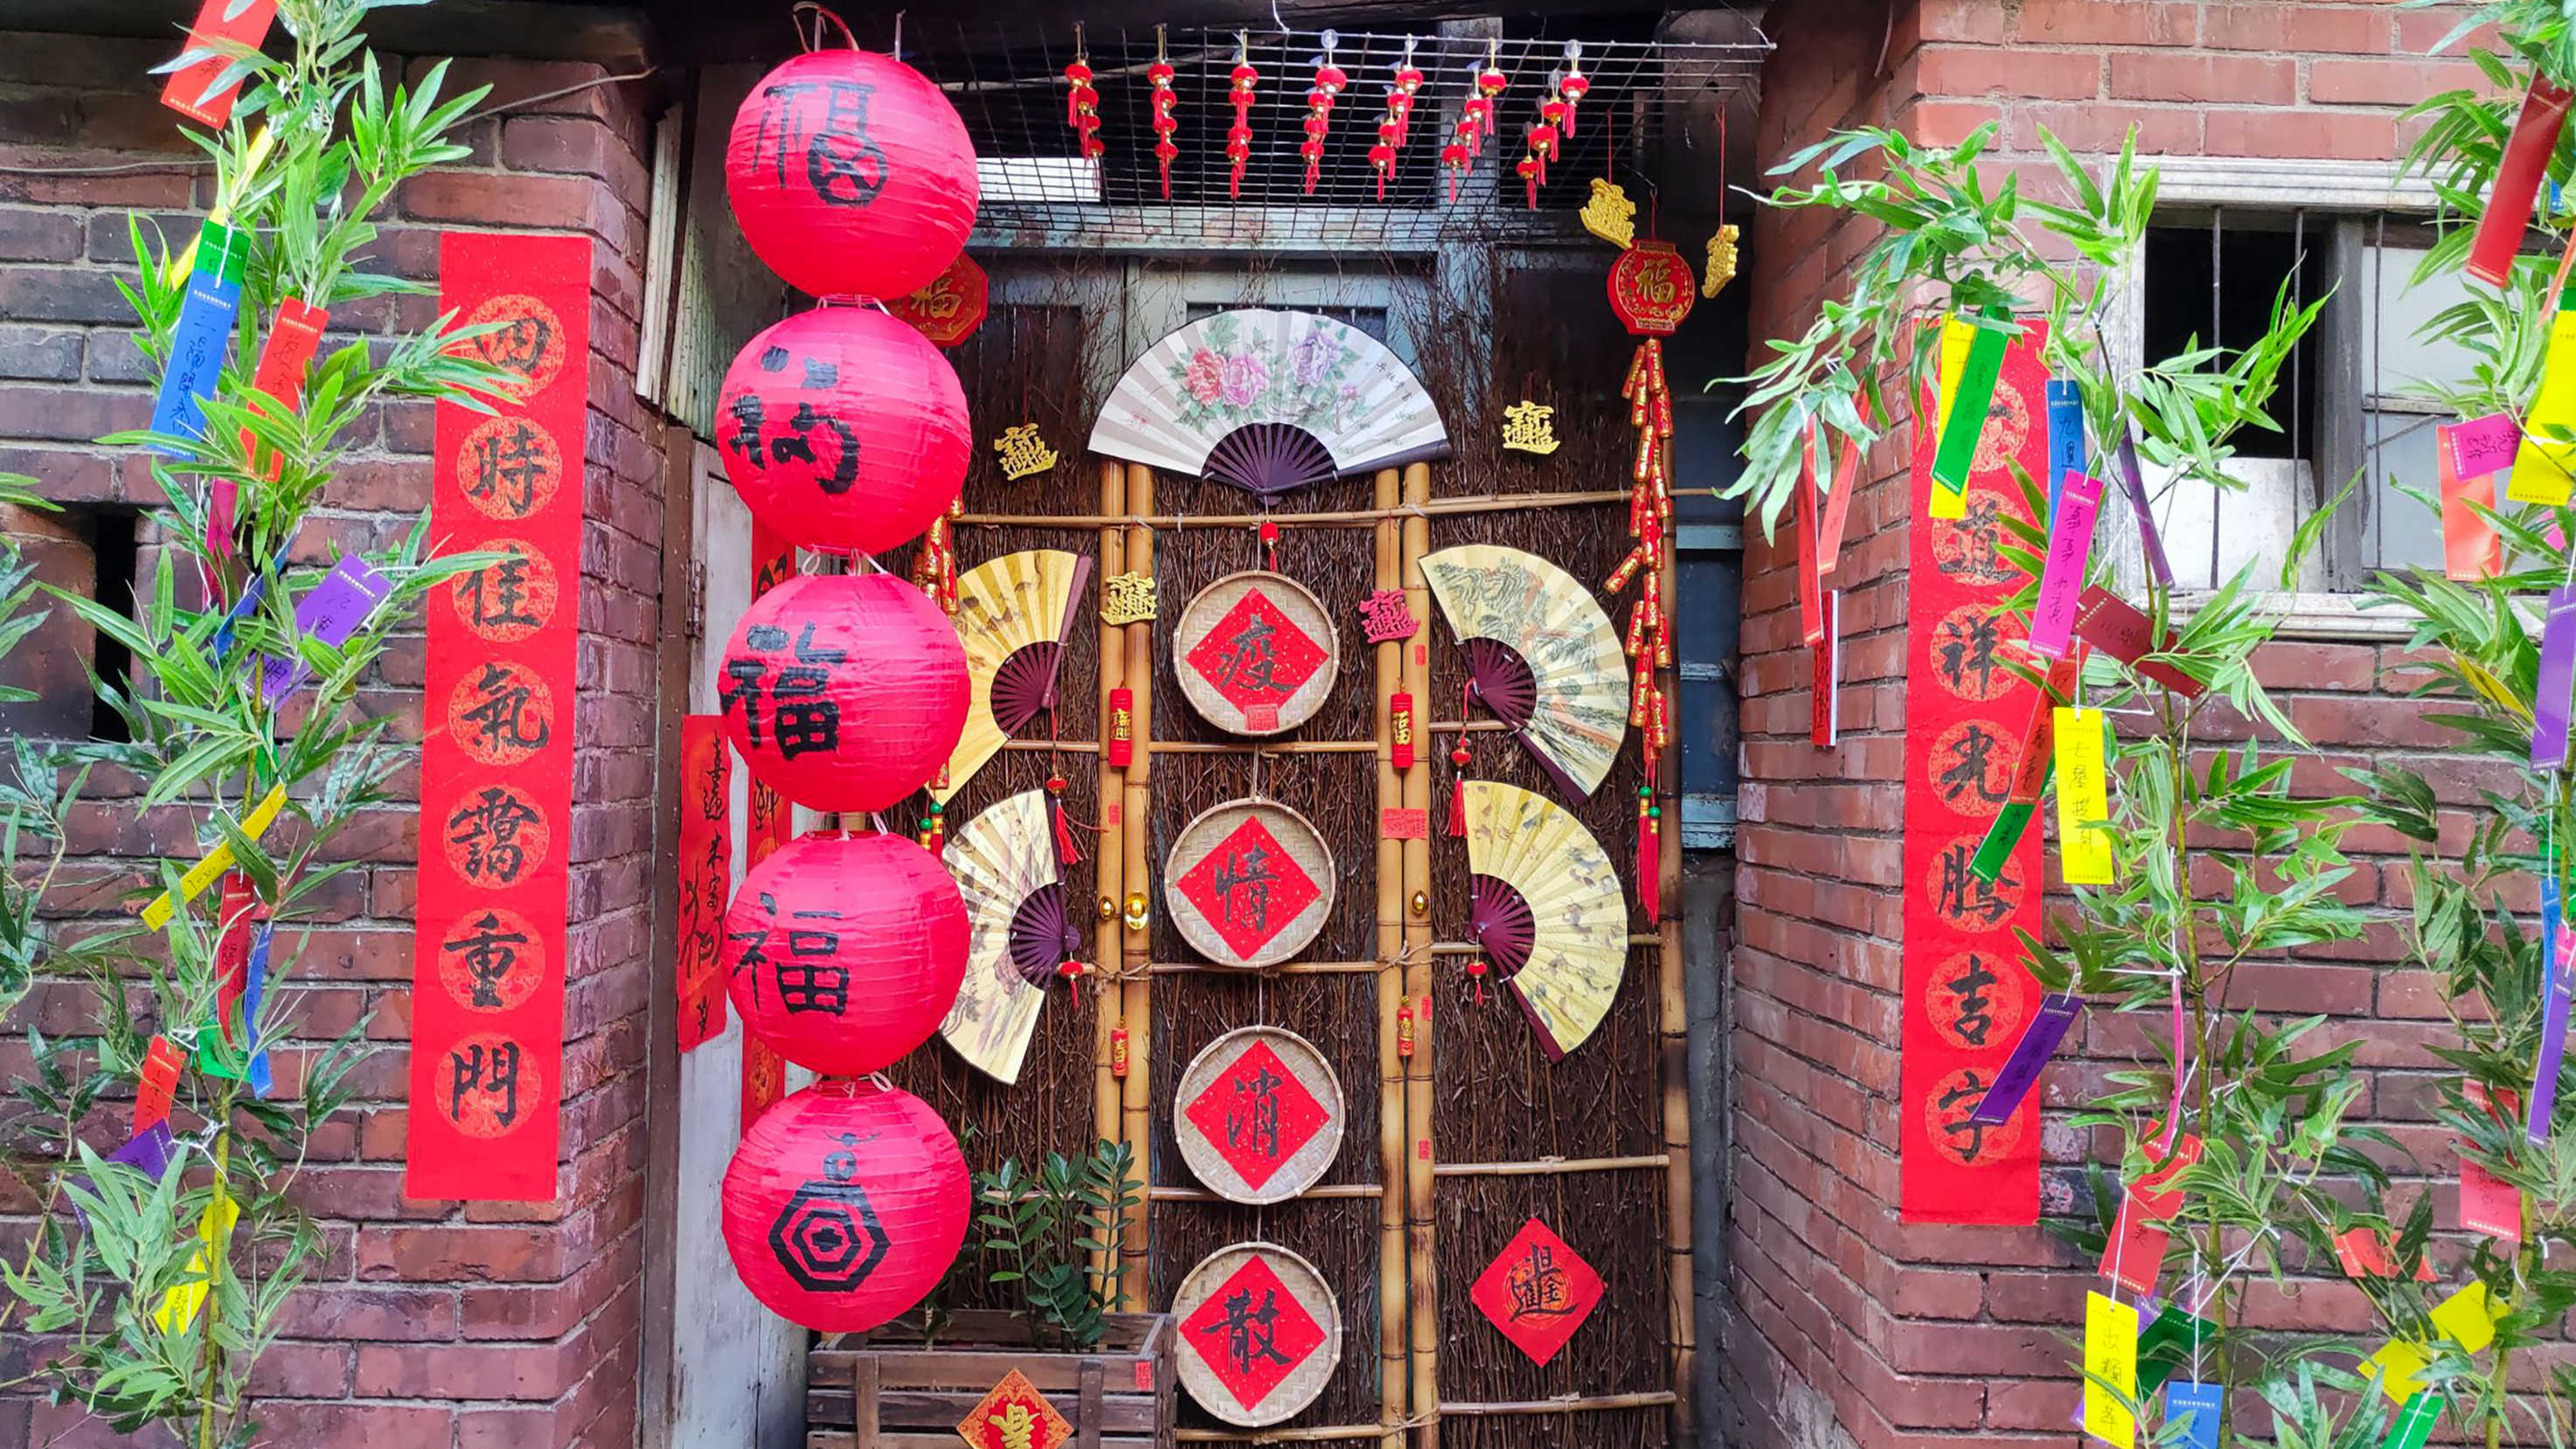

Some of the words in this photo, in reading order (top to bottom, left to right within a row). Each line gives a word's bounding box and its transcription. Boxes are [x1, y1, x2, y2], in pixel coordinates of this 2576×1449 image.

[909, 269, 962, 318] 福
[1635, 258, 1677, 304] 福
[719, 621, 846, 760] 福
[1219, 614, 1298, 692] 疫
[1214, 843, 1282, 932] 情
[729, 892, 848, 1016] 福
[1226, 1067, 1282, 1157] 消
[1202, 1287, 1291, 1375] 散
